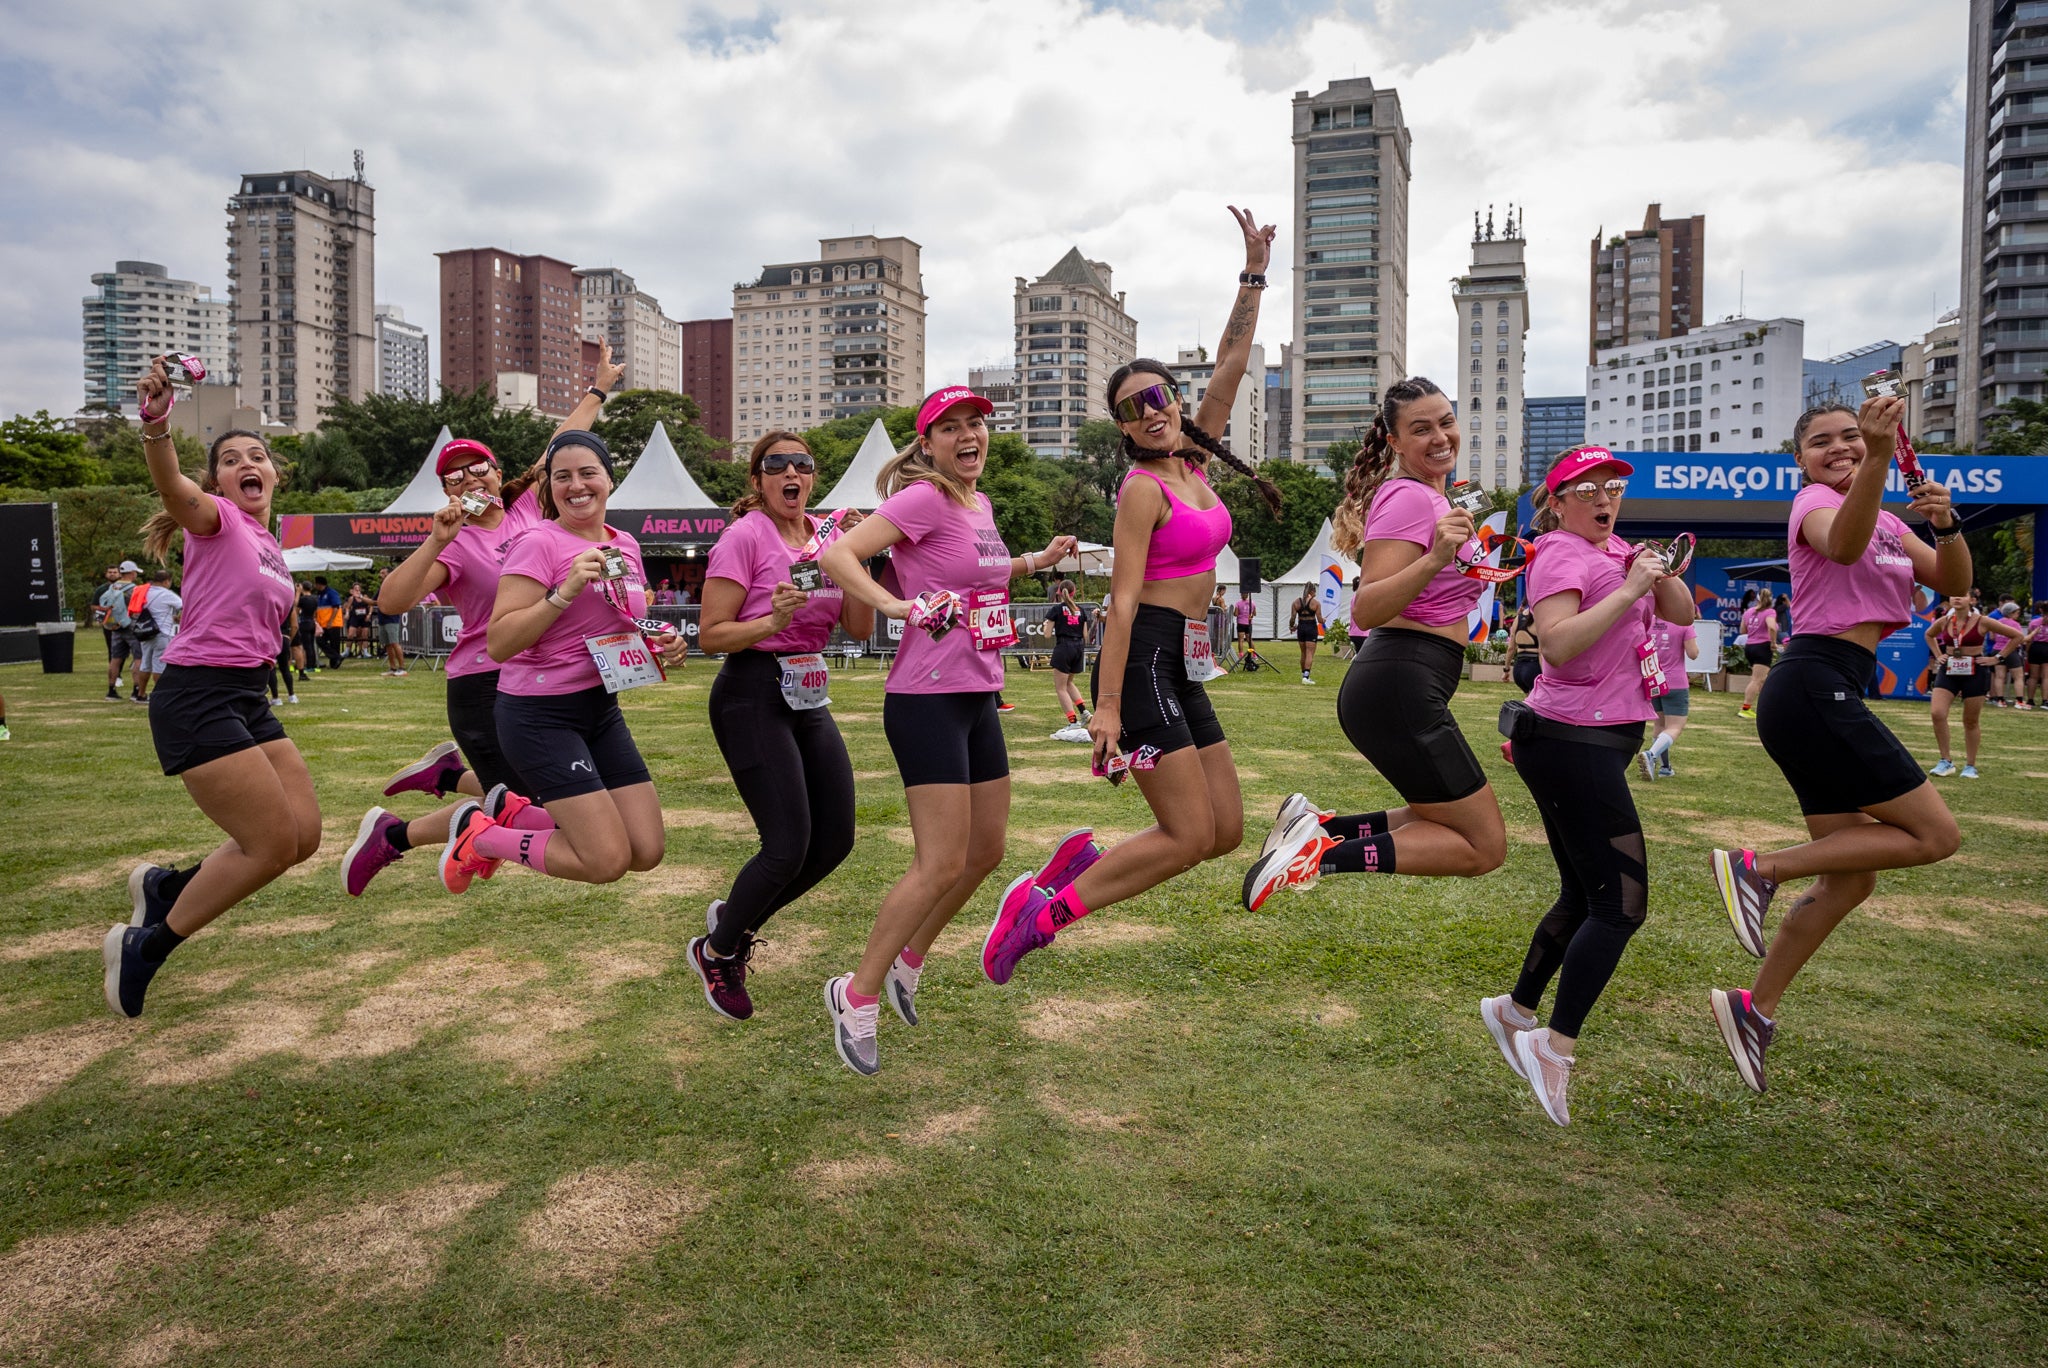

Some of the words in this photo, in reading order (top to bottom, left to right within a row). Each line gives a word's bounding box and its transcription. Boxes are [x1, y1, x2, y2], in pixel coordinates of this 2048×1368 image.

[940, 390, 970, 403] Jeep
[1576, 451, 1608, 463] Jeep
[1655, 465, 1770, 498] ESPAÇO
[1776, 466, 1802, 491] IT
[641, 514, 693, 534] ÁREA
[694, 518, 726, 534] VIP
[817, 516, 838, 539] 2024
[380, 534, 400, 544] HALF
[1477, 567, 1493, 576] VENUS
[889, 623, 904, 635] ita
[618, 648, 649, 667] 4151
[1191, 640, 1211, 660] 3349
[801, 670, 827, 688] 4189
[1358, 821, 1372, 839] 15
[519, 832, 535, 868] 10K
[1049, 896, 1076, 927] RUN
